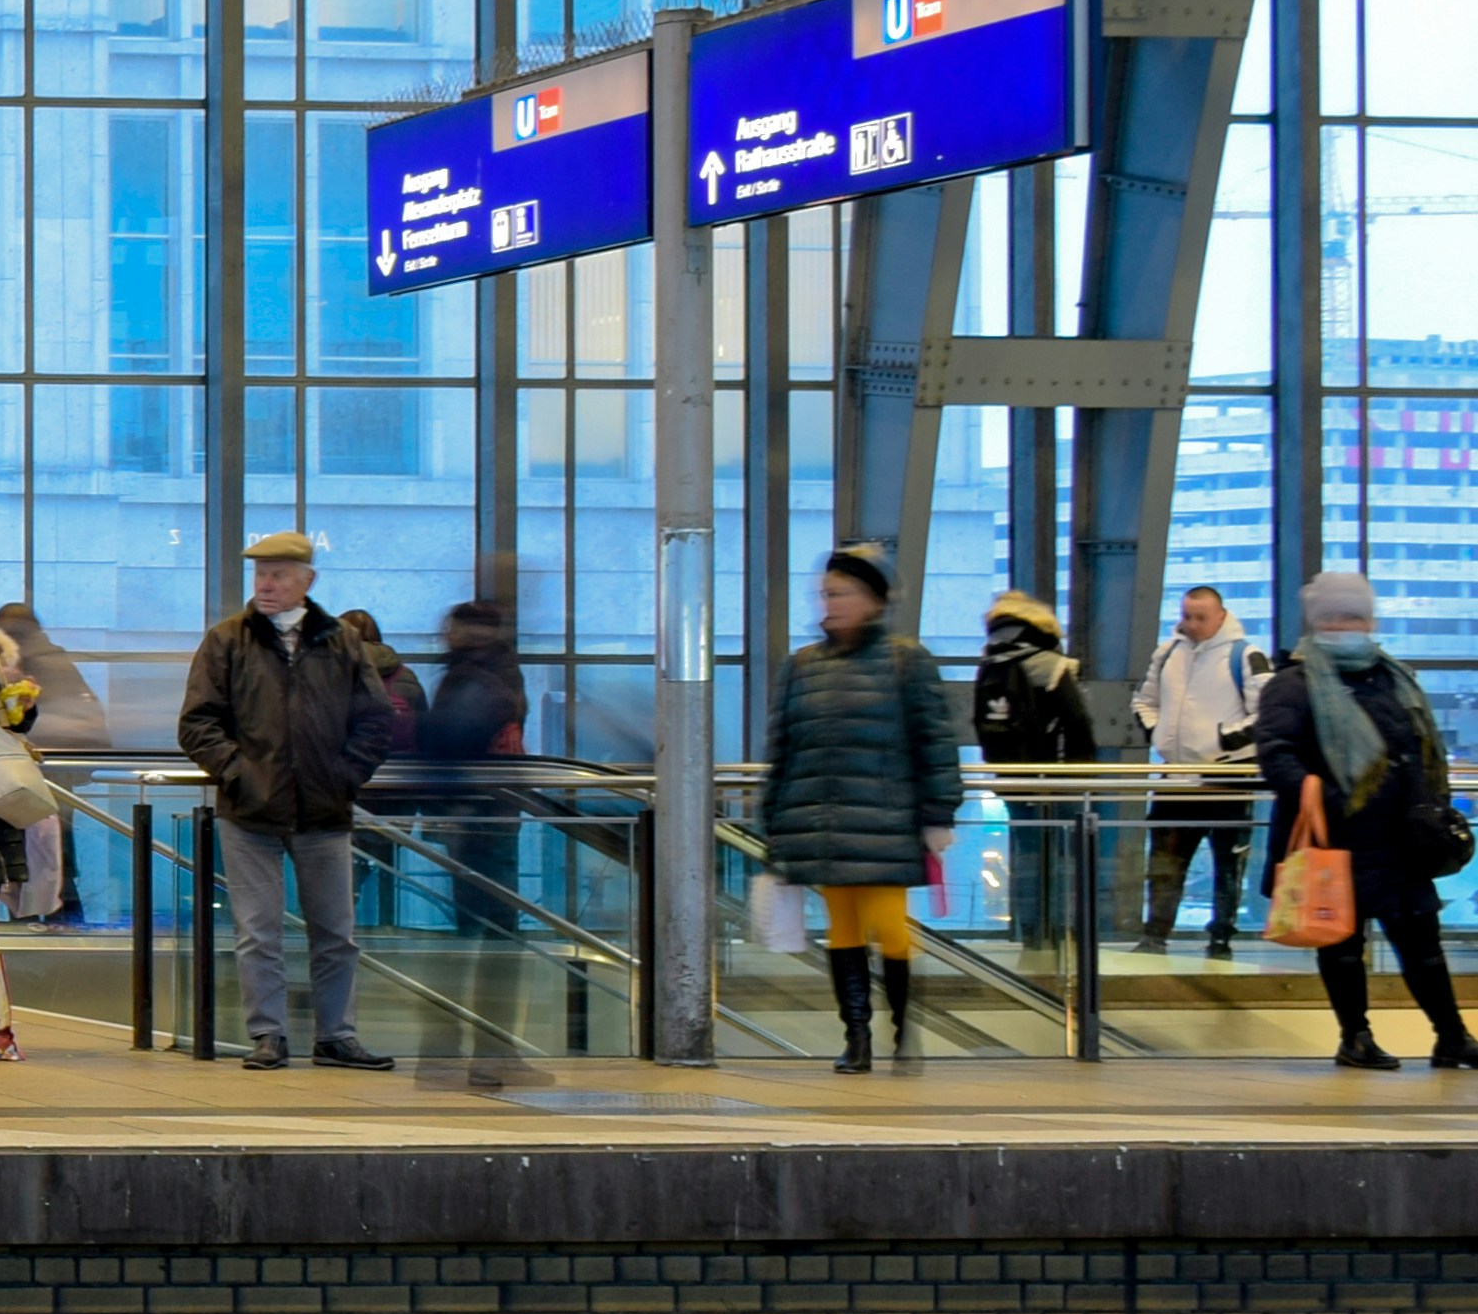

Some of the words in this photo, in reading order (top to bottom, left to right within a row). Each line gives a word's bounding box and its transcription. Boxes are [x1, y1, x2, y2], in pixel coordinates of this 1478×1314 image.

[916, 0, 942, 20] Tram
[517, 97, 536, 137] U
[735, 111, 798, 141] Ausgang
